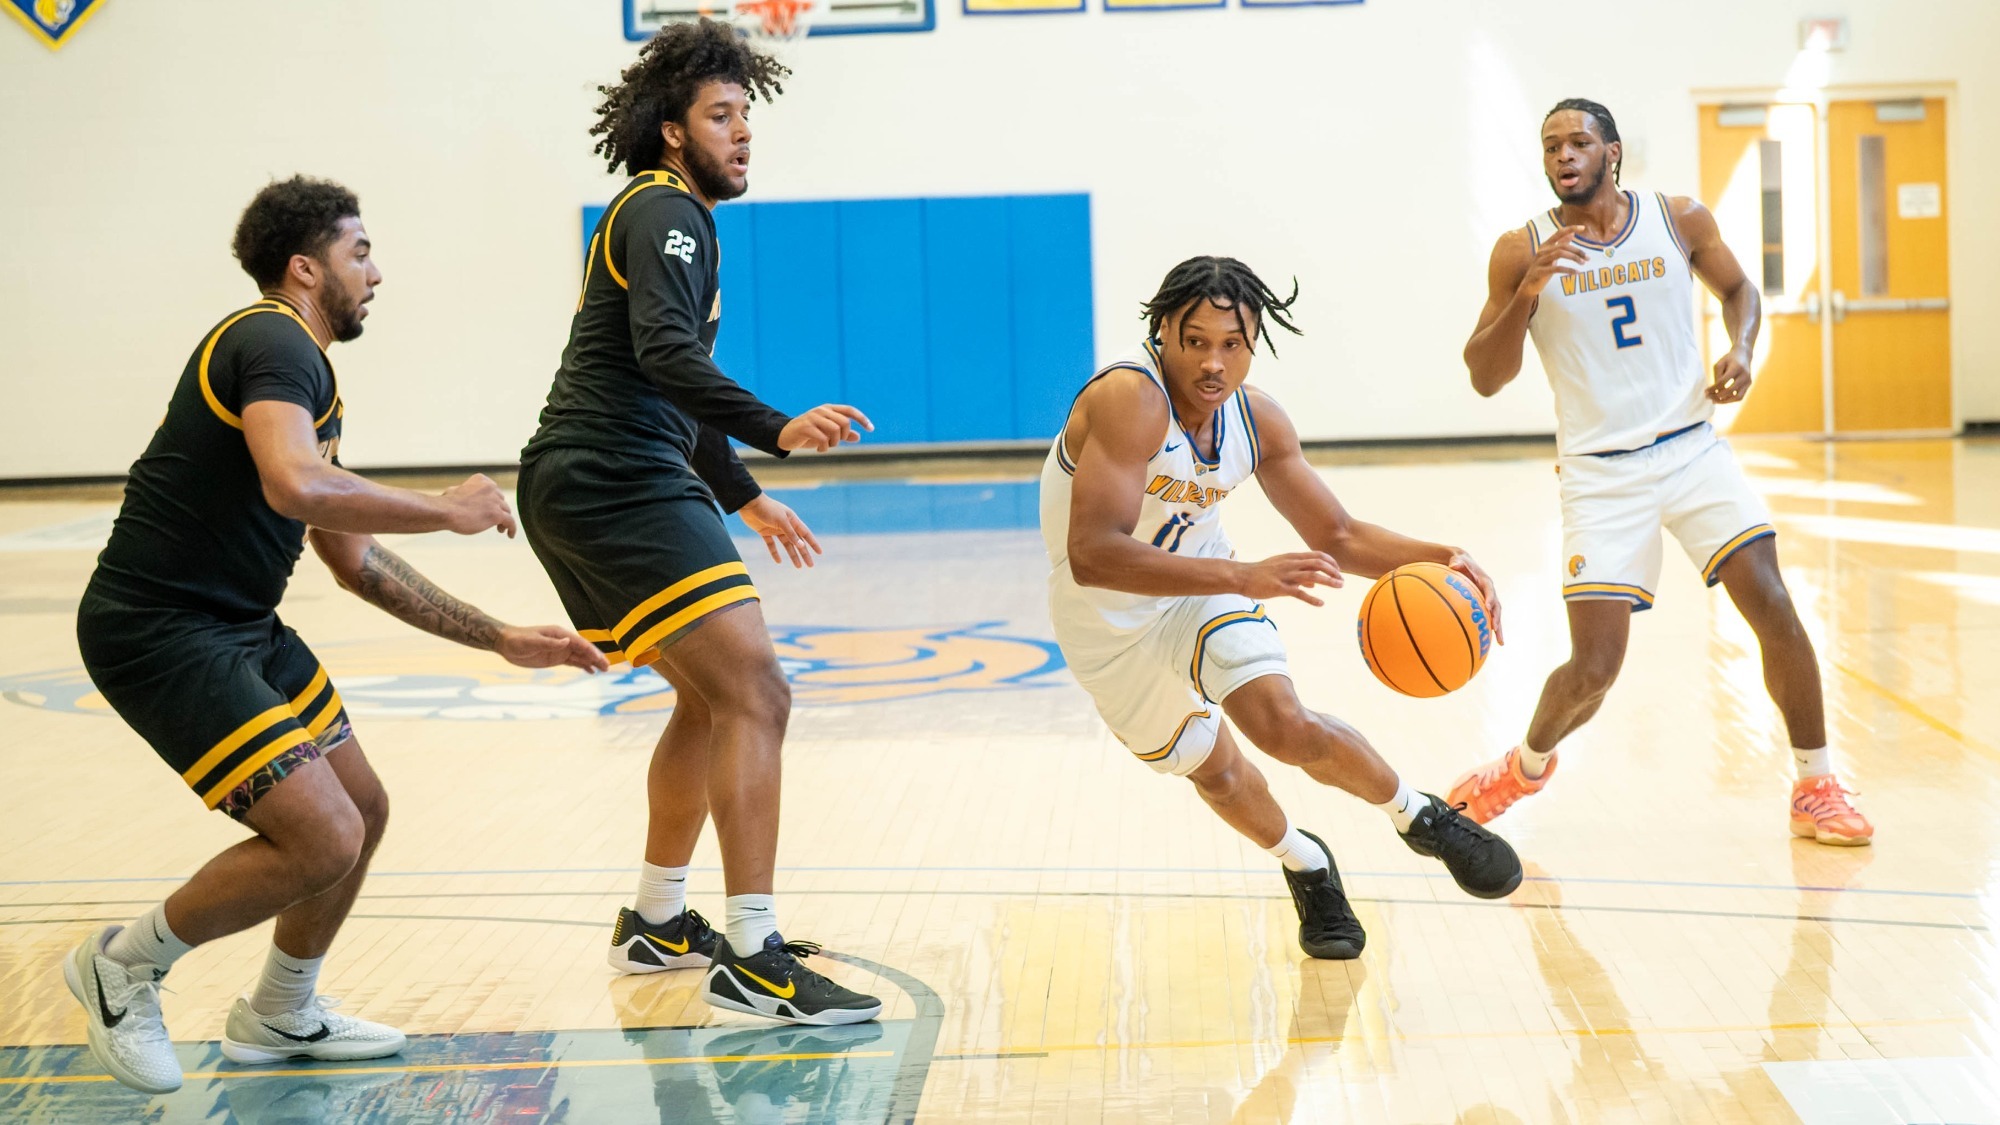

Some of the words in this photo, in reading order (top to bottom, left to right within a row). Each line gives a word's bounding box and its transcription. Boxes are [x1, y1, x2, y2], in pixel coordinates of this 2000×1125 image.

[663, 229, 697, 265] 22
[1560, 256, 1667, 297] WILDCATS
[1604, 293, 1645, 351] 2
[1444, 574, 1493, 660] Wilson
